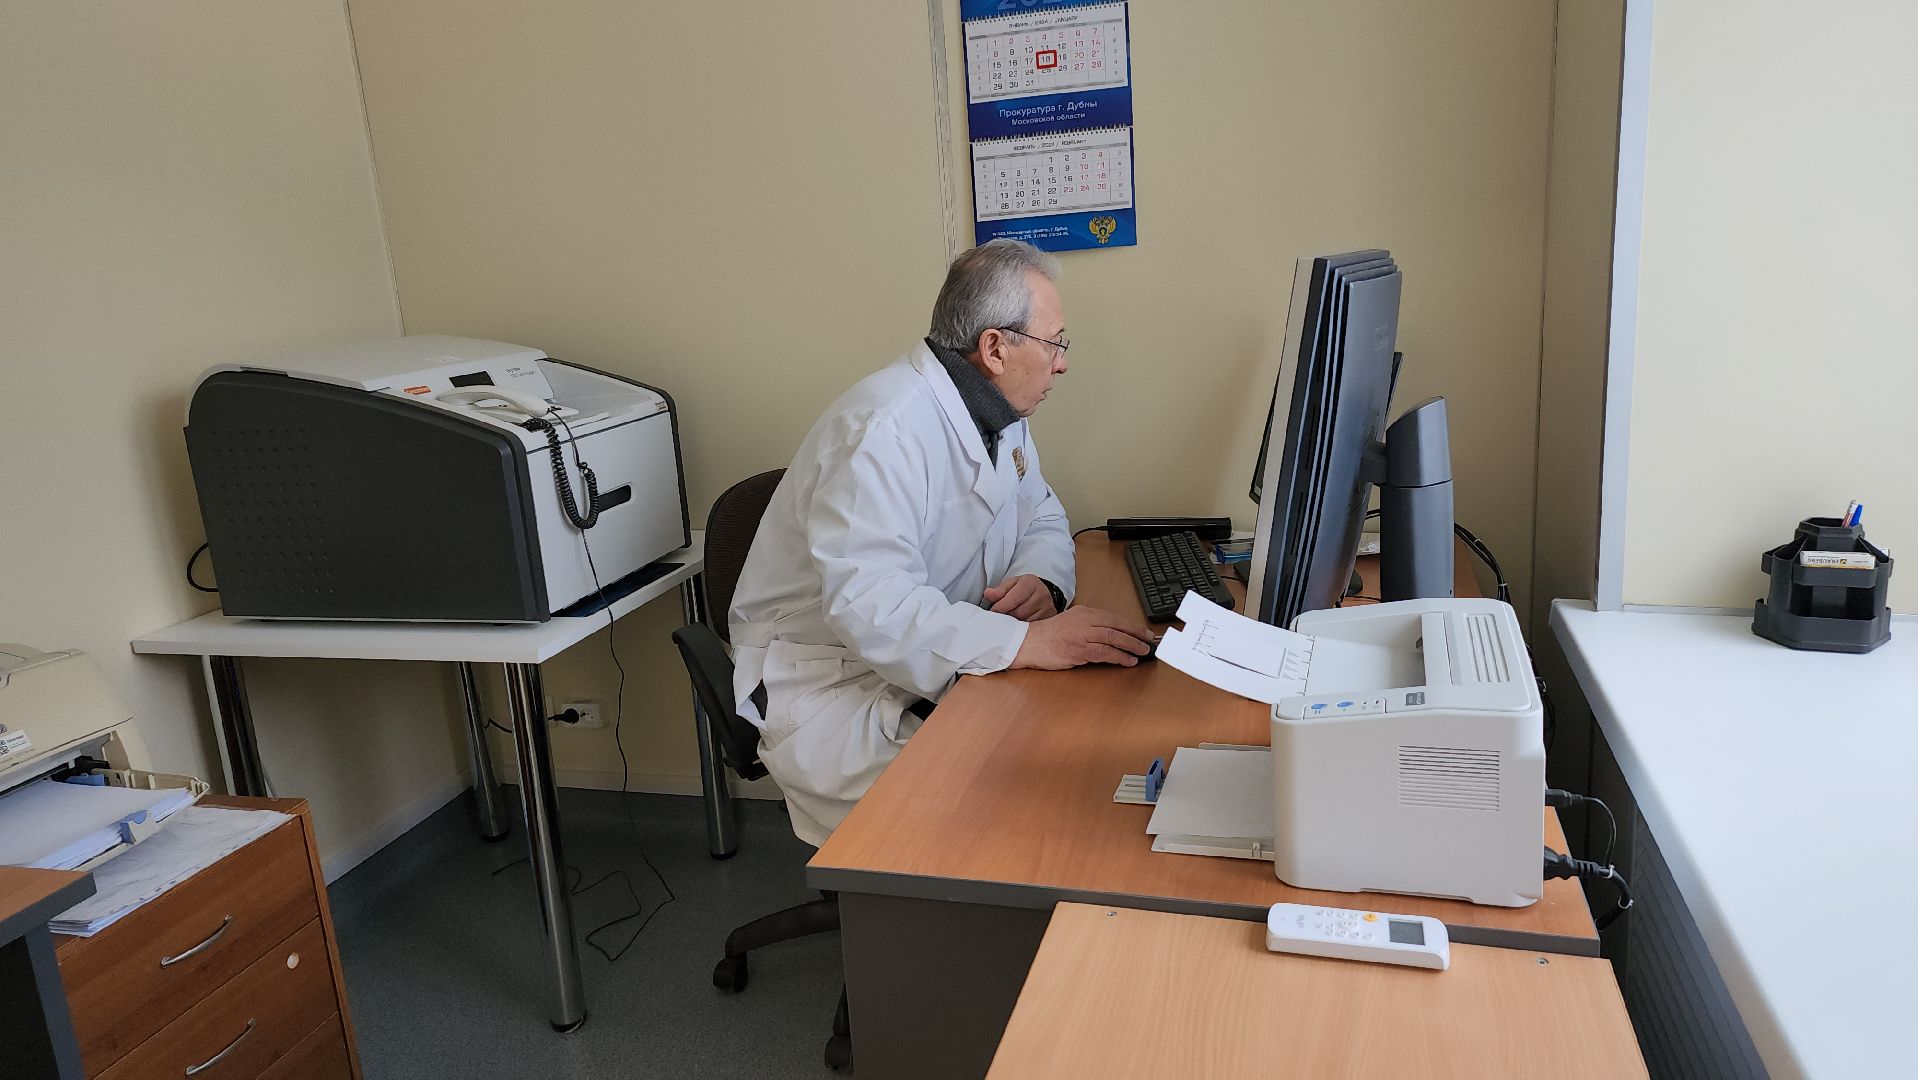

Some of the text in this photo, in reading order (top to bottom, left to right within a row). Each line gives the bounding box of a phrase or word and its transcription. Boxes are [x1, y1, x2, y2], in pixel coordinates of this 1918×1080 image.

[999, 105, 1056, 118] Прокуратура
[1067, 101, 1098, 111] Дубны
[1011, 112, 1086, 126] Московской области
